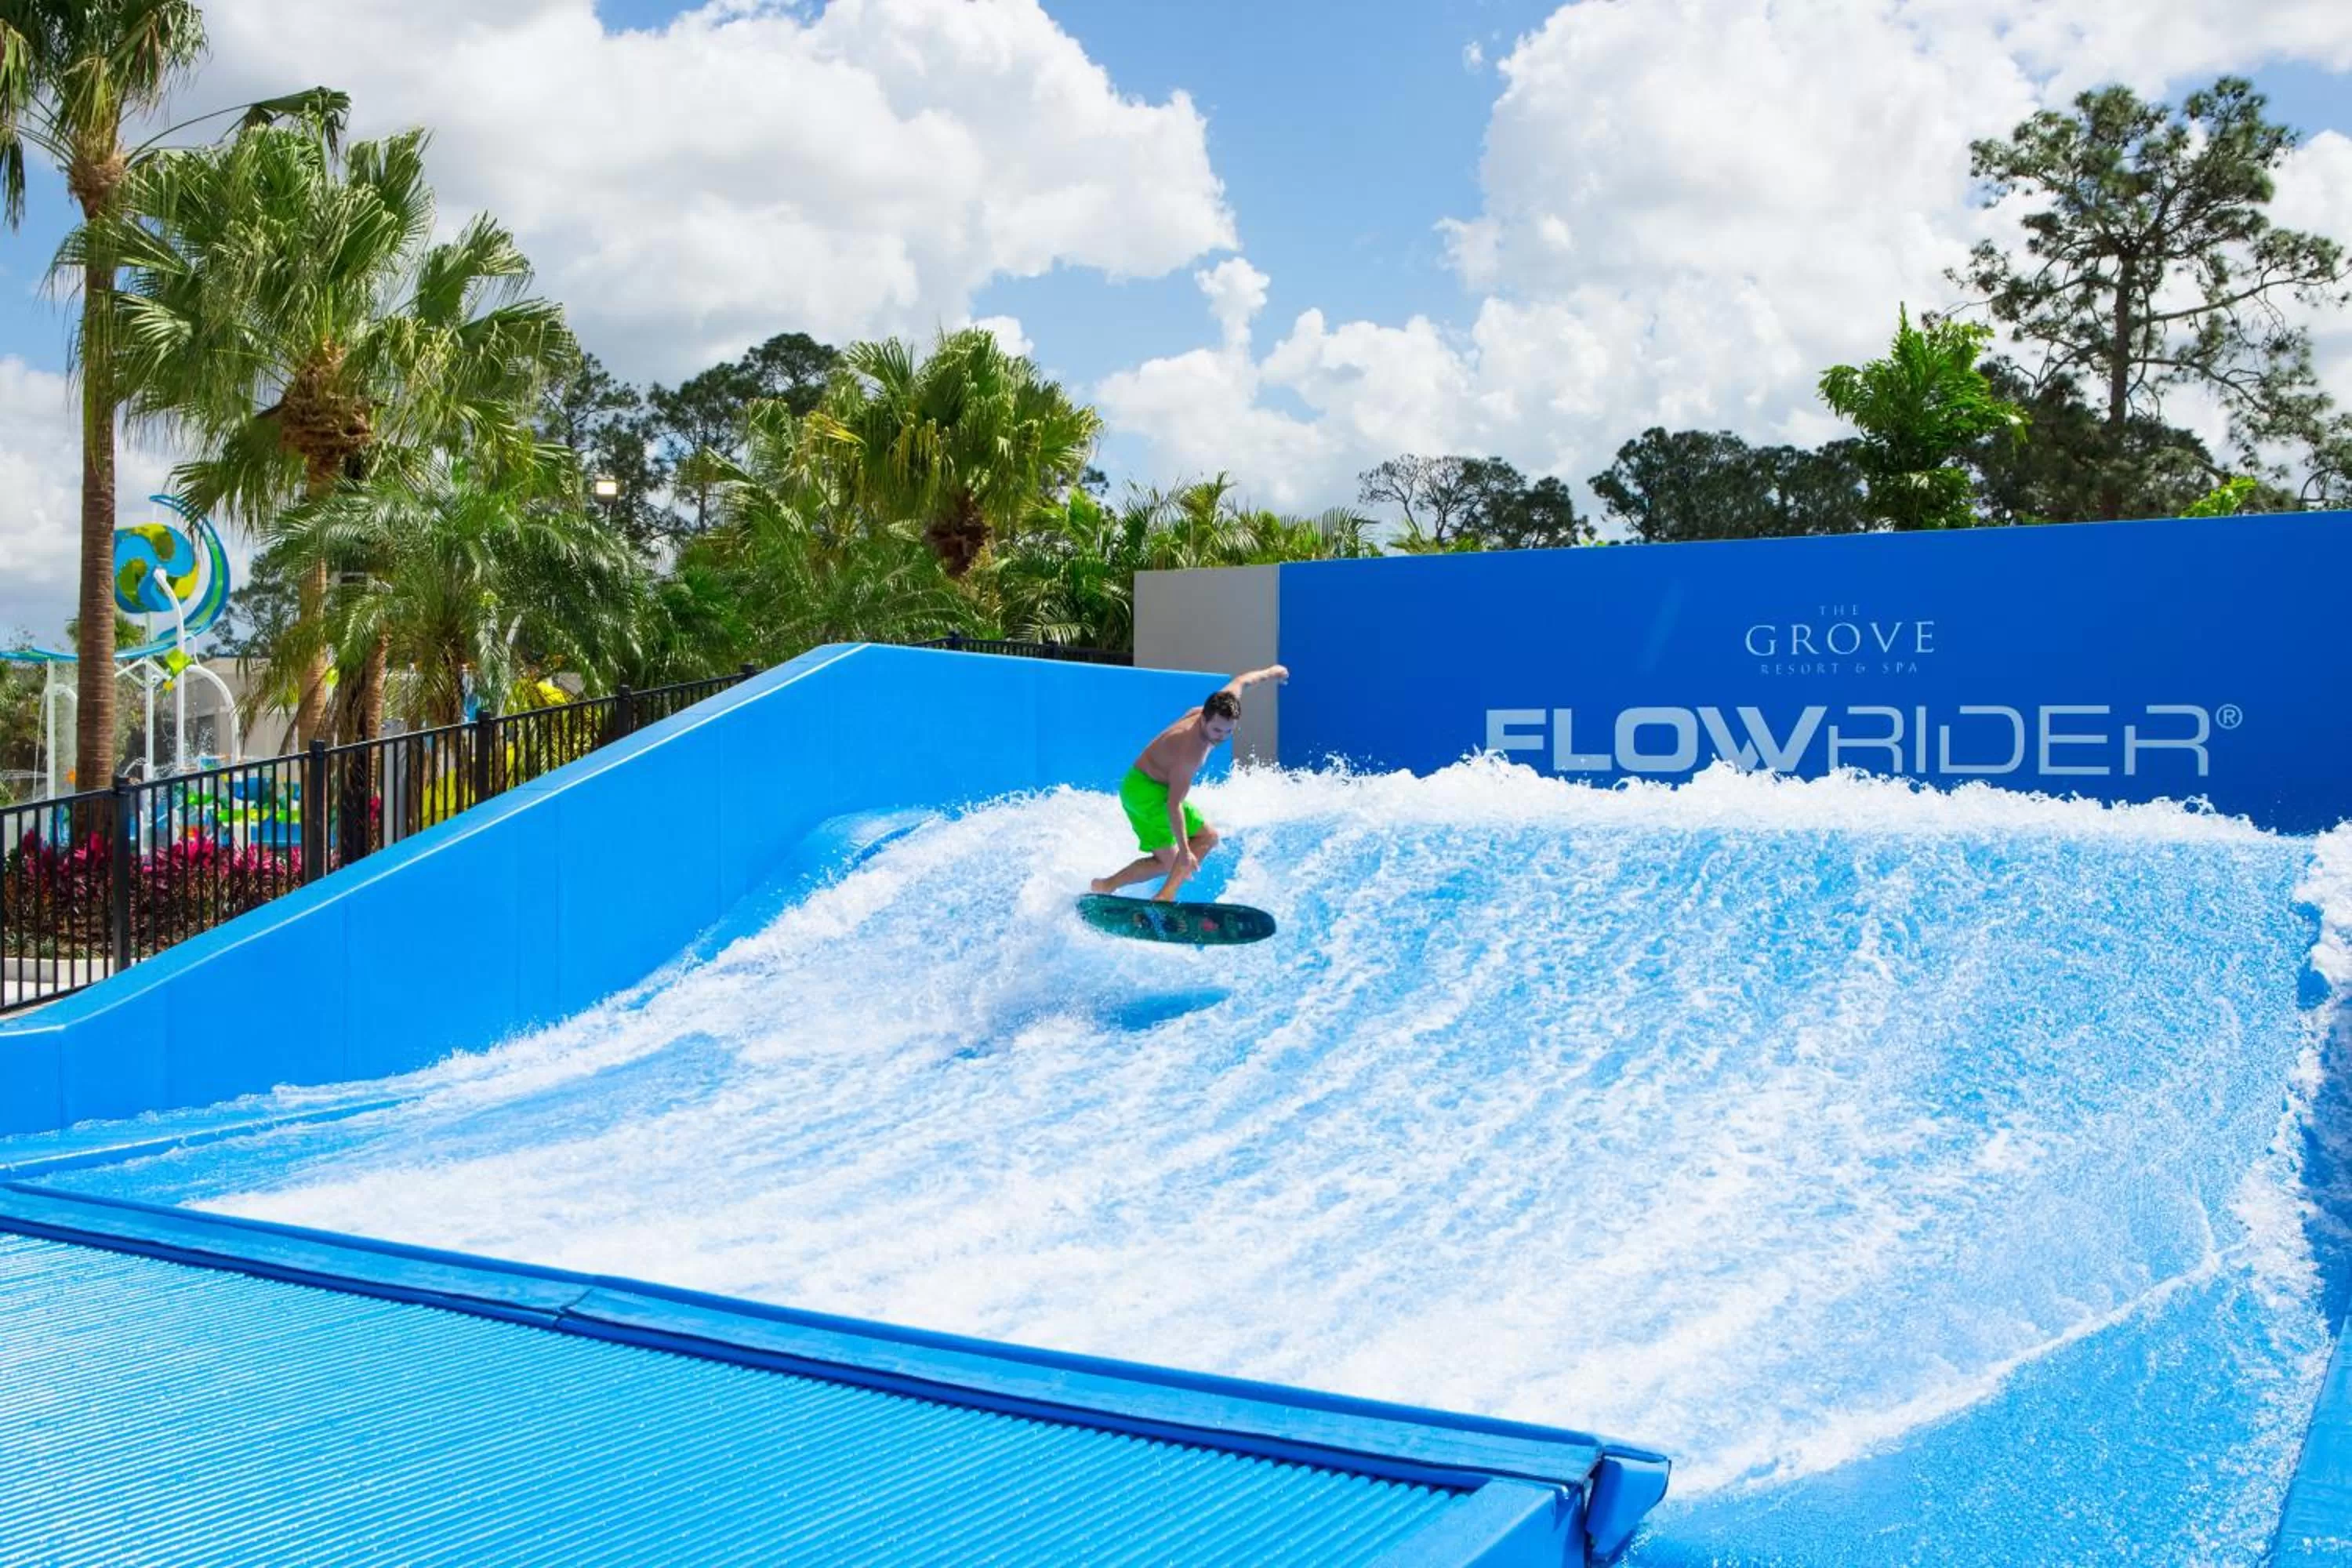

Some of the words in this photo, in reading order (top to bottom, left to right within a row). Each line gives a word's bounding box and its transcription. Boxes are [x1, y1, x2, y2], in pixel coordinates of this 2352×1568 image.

[1819, 604, 1860, 615] THE
[1744, 620, 1936, 656] GROVE
[1760, 662, 1839, 675] RESORT
[1855, 663, 1867, 673] &
[1882, 662, 1918, 673] SPA
